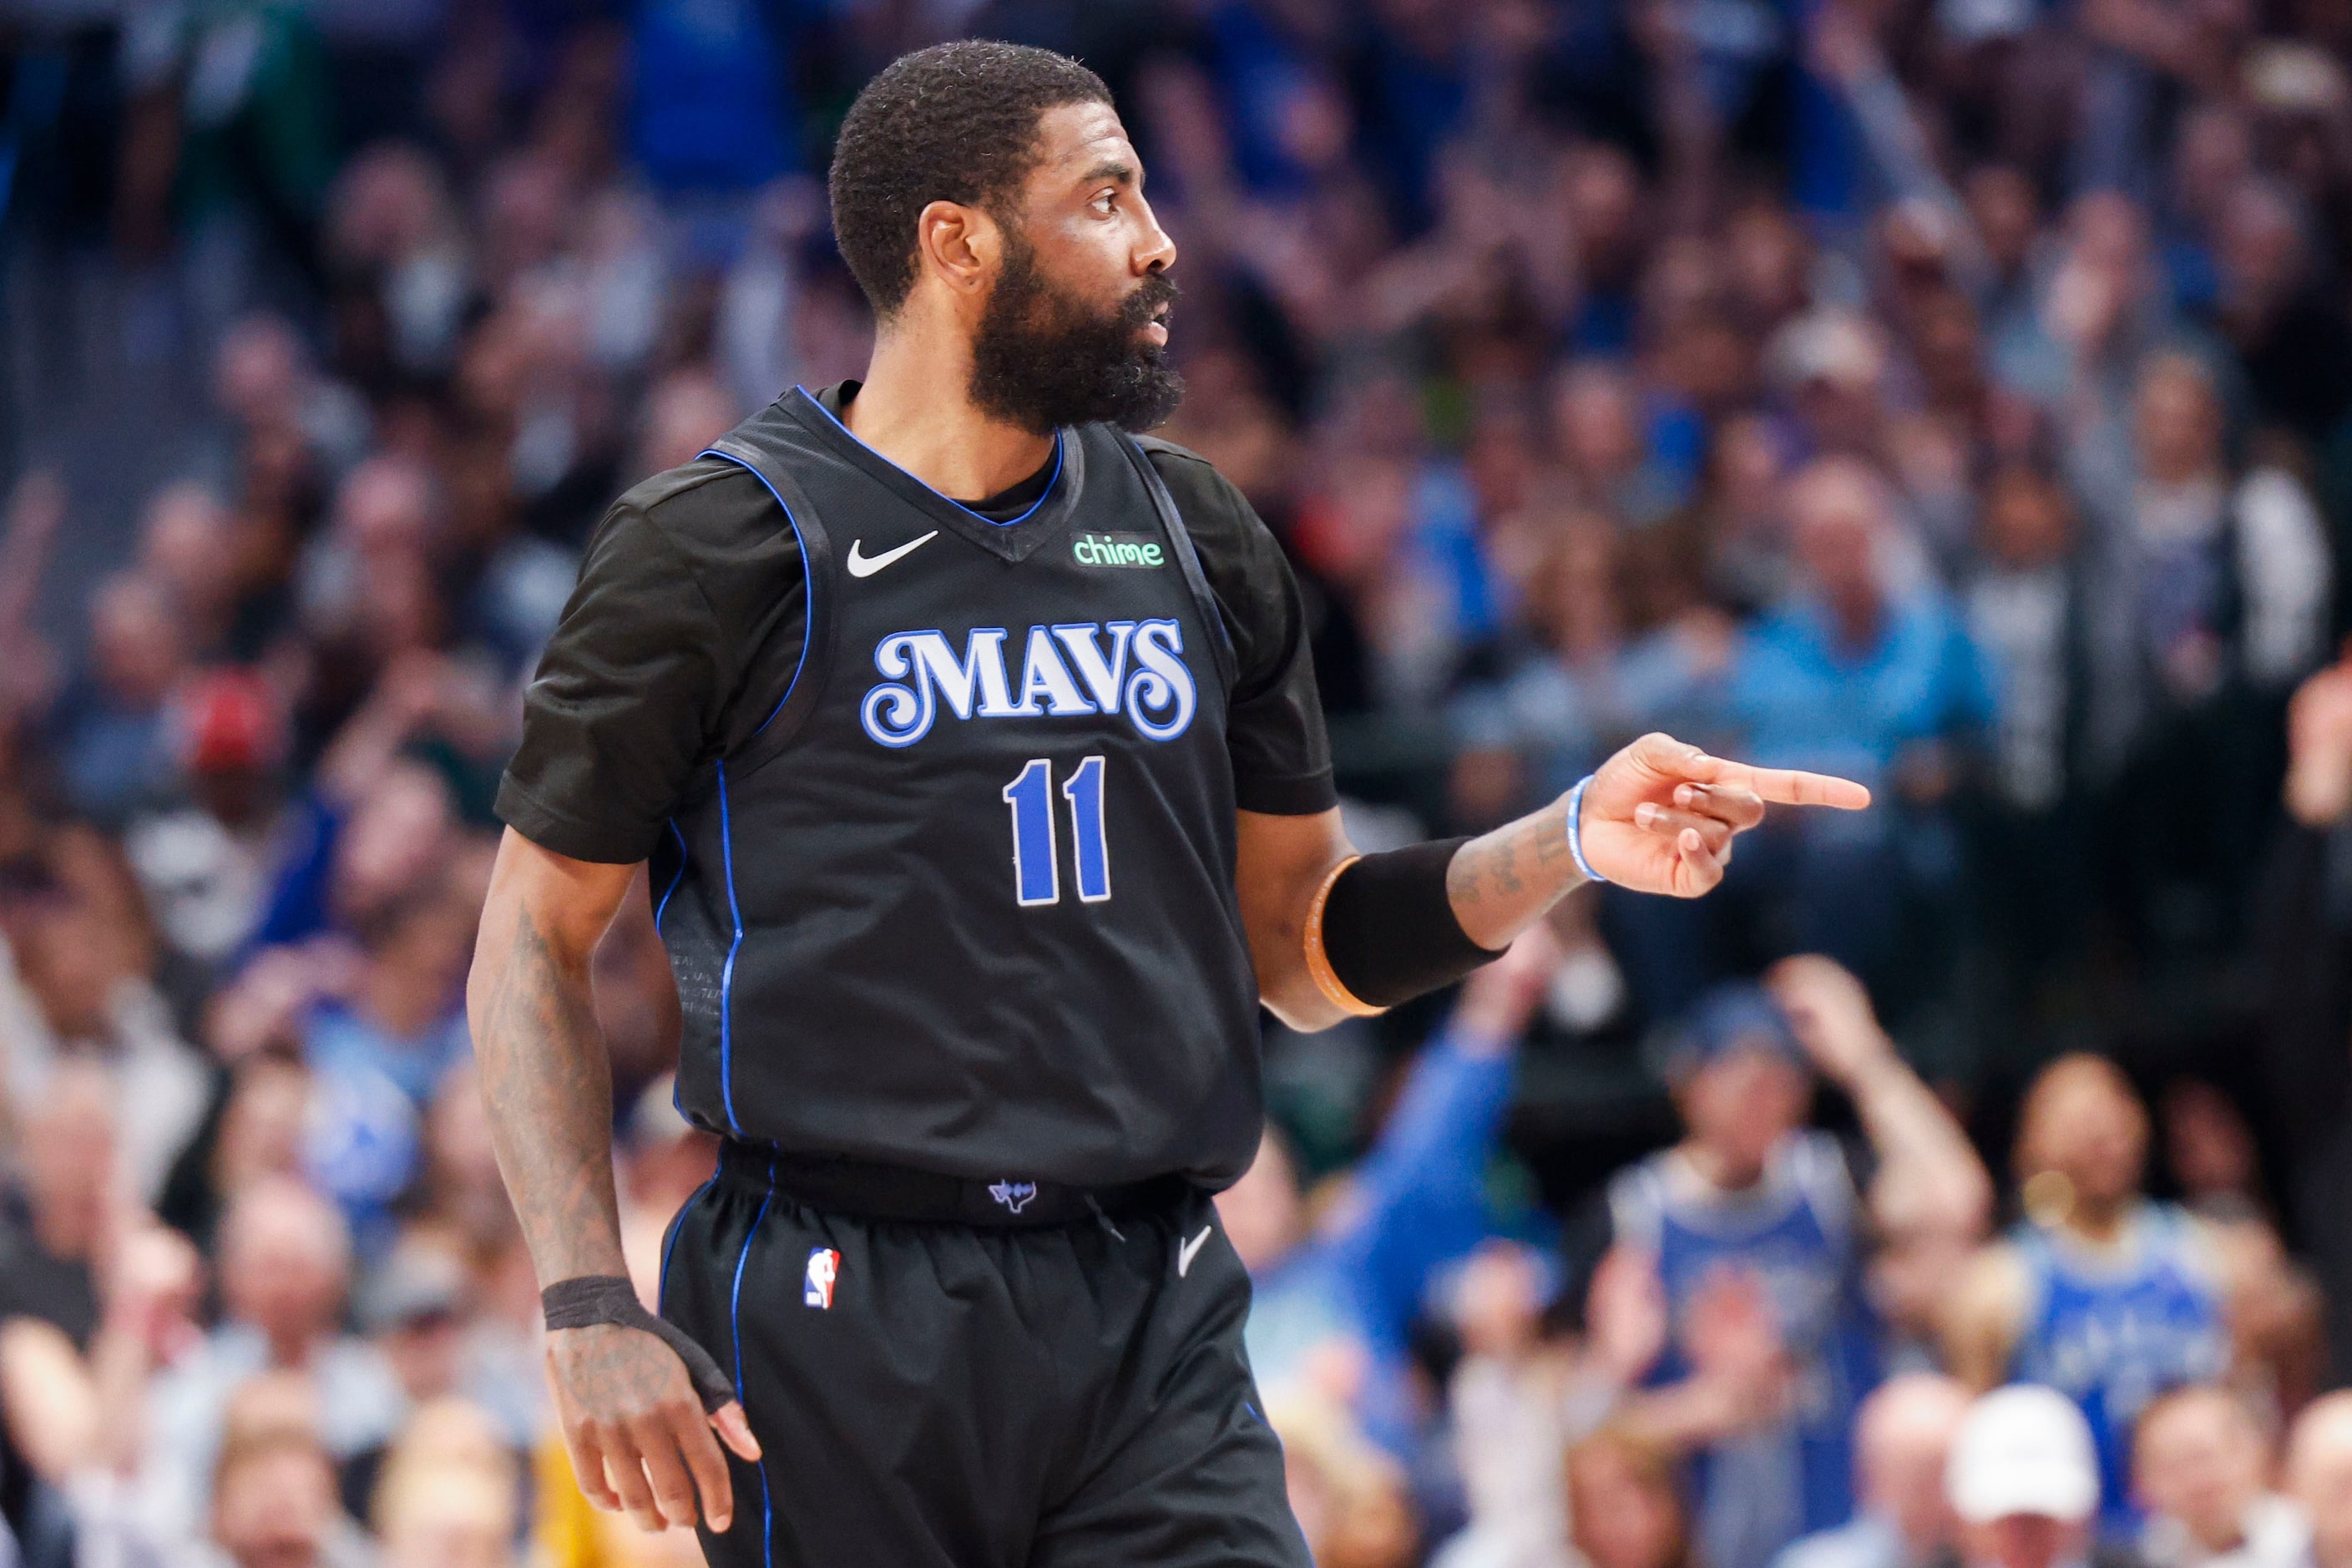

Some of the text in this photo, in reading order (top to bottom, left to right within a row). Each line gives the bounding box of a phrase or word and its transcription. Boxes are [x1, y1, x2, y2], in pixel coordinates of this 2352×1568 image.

[1074, 534, 1165, 567] chime
[861, 619, 1196, 748] MAVS
[1003, 756, 1111, 907] 11
